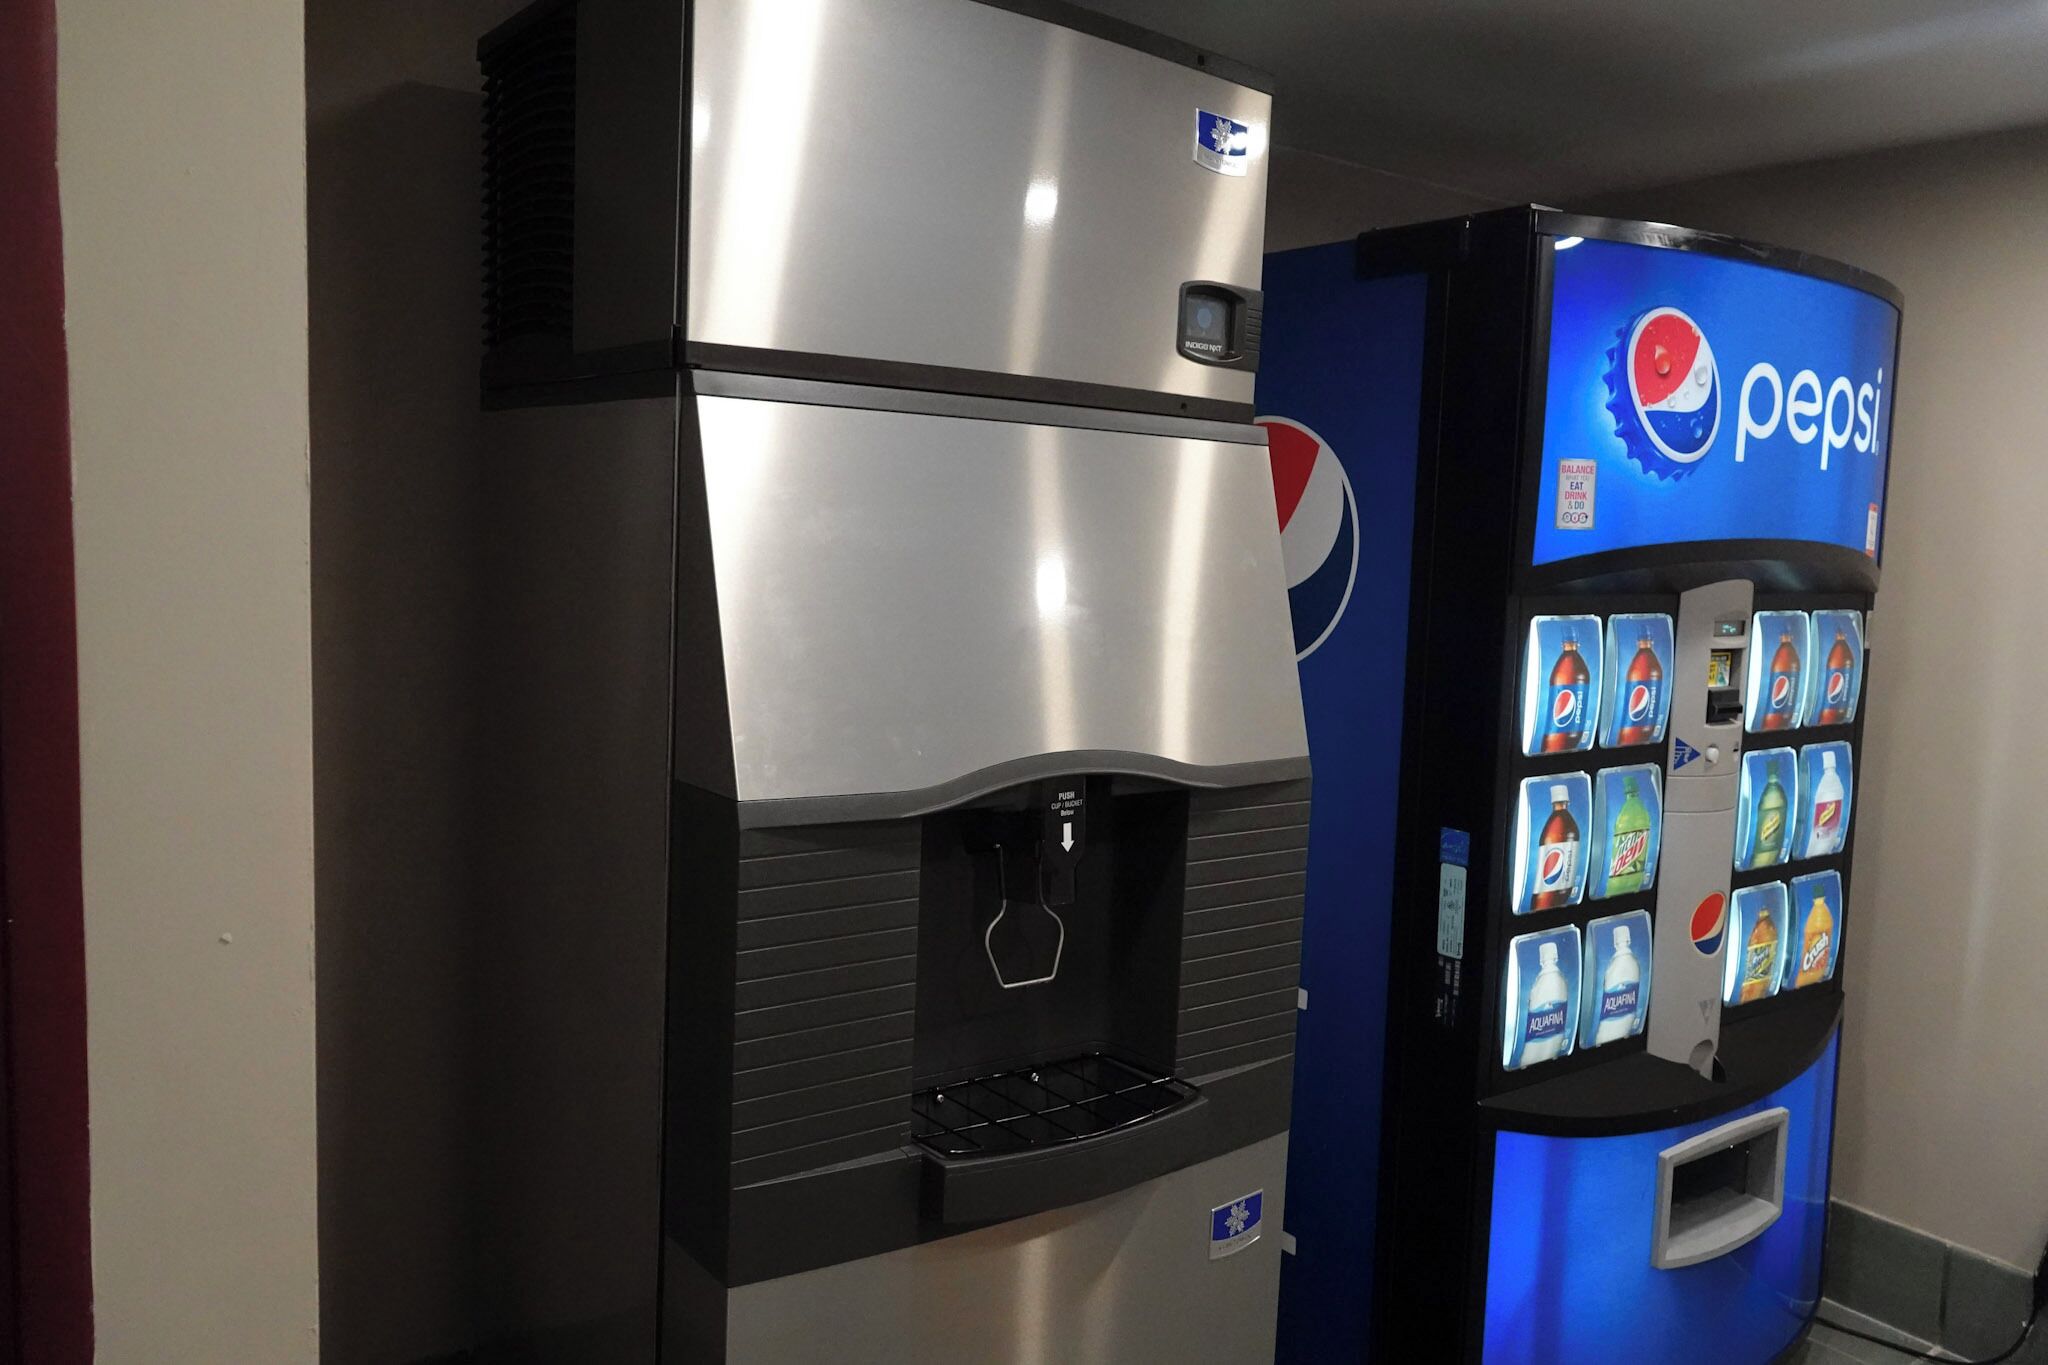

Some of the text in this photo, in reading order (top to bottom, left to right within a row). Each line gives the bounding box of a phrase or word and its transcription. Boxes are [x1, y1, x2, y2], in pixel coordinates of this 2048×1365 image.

[1735, 362, 1883, 471] pepsi
[1561, 464, 1595, 474] BALANCE
[1570, 481, 1584, 490] EAT
[1564, 491, 1587, 501] DRINK
[1574, 501, 1584, 510] DO
[1575, 690, 1583, 724] pepsi
[1648, 686, 1657, 718] pepsi
[1058, 791, 1075, 800] PUSH
[1050, 801, 1061, 810] CUP
[1065, 799, 1083, 808] BUCKET
[1060, 809, 1074, 817] Below
[1803, 932, 1829, 971] Crush
[1604, 991, 1636, 1013] AQUAFINA
[1528, 1010, 1564, 1034] AQUAFINA
